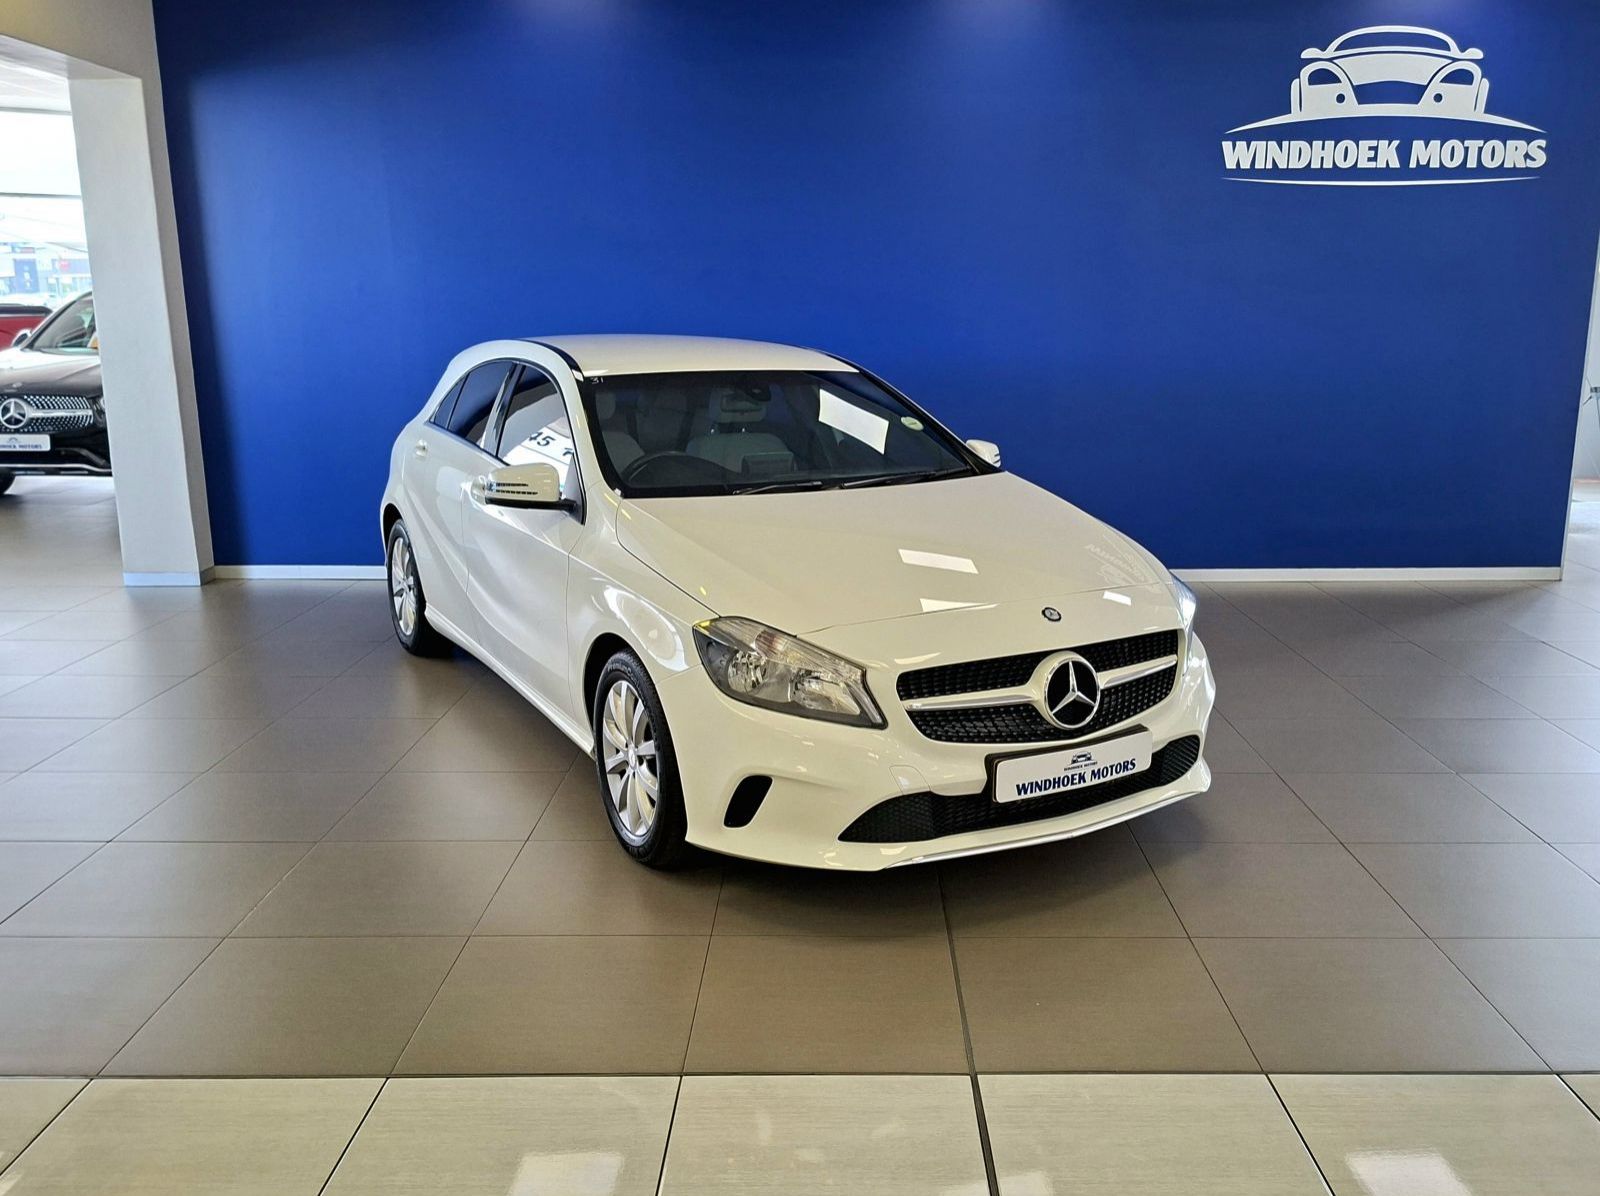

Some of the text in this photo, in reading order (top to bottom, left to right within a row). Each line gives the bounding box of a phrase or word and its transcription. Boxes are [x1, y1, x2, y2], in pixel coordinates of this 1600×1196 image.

[1222, 139, 1546, 169] WINDHOEK MOTORS
[1016, 758, 1136, 796] WINDHOEK MOTORS
